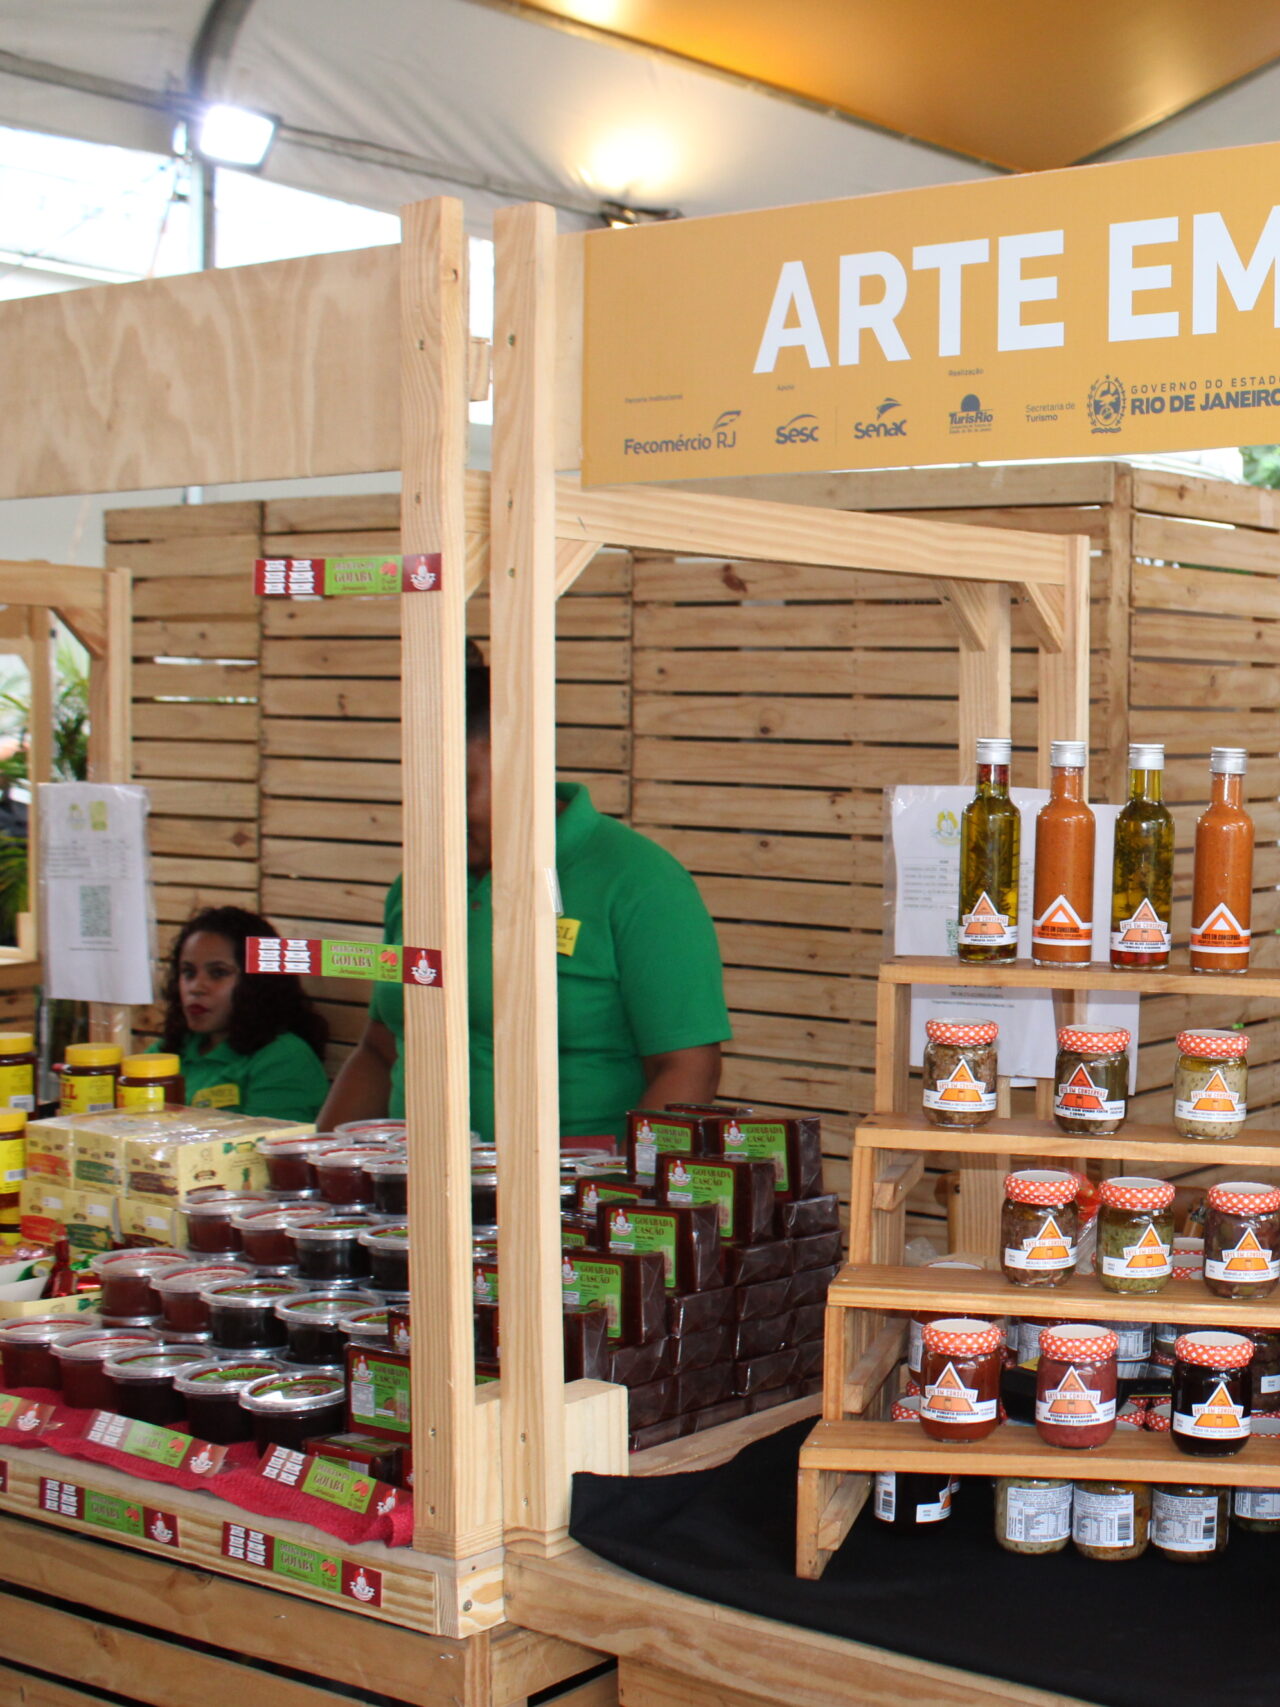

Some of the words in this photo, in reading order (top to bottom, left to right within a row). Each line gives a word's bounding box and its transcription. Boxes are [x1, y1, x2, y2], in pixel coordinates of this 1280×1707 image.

[752, 229, 1065, 375] ARTE
[1131, 380, 1198, 395] GOVERNO
[1205, 379, 1223, 389] DO
[1025, 404, 1064, 413] Secretaria
[1065, 402, 1076, 411] de
[1130, 396, 1166, 415] RIO
[1169, 394, 1196, 413] DE
[948, 410, 994, 424] TurisRio
[1025, 413, 1059, 423] Turismo
[774, 425, 819, 445] Sesc
[853, 419, 908, 440] Senac
[623, 434, 712, 455] Fecomércio
[716, 430, 737, 449] RJ
[331, 954, 374, 968] GOIABA
[692, 1168, 730, 1178] GOIABADA
[692, 1176, 723, 1186] CASCÃO
[634, 1216, 673, 1227] GOIABADA
[634, 1225, 665, 1235] CASCÃO
[579, 1265, 618, 1276] GOIABADA
[579, 1274, 610, 1284] CASCÃO
[313, 1472, 346, 1494] GOIABA
